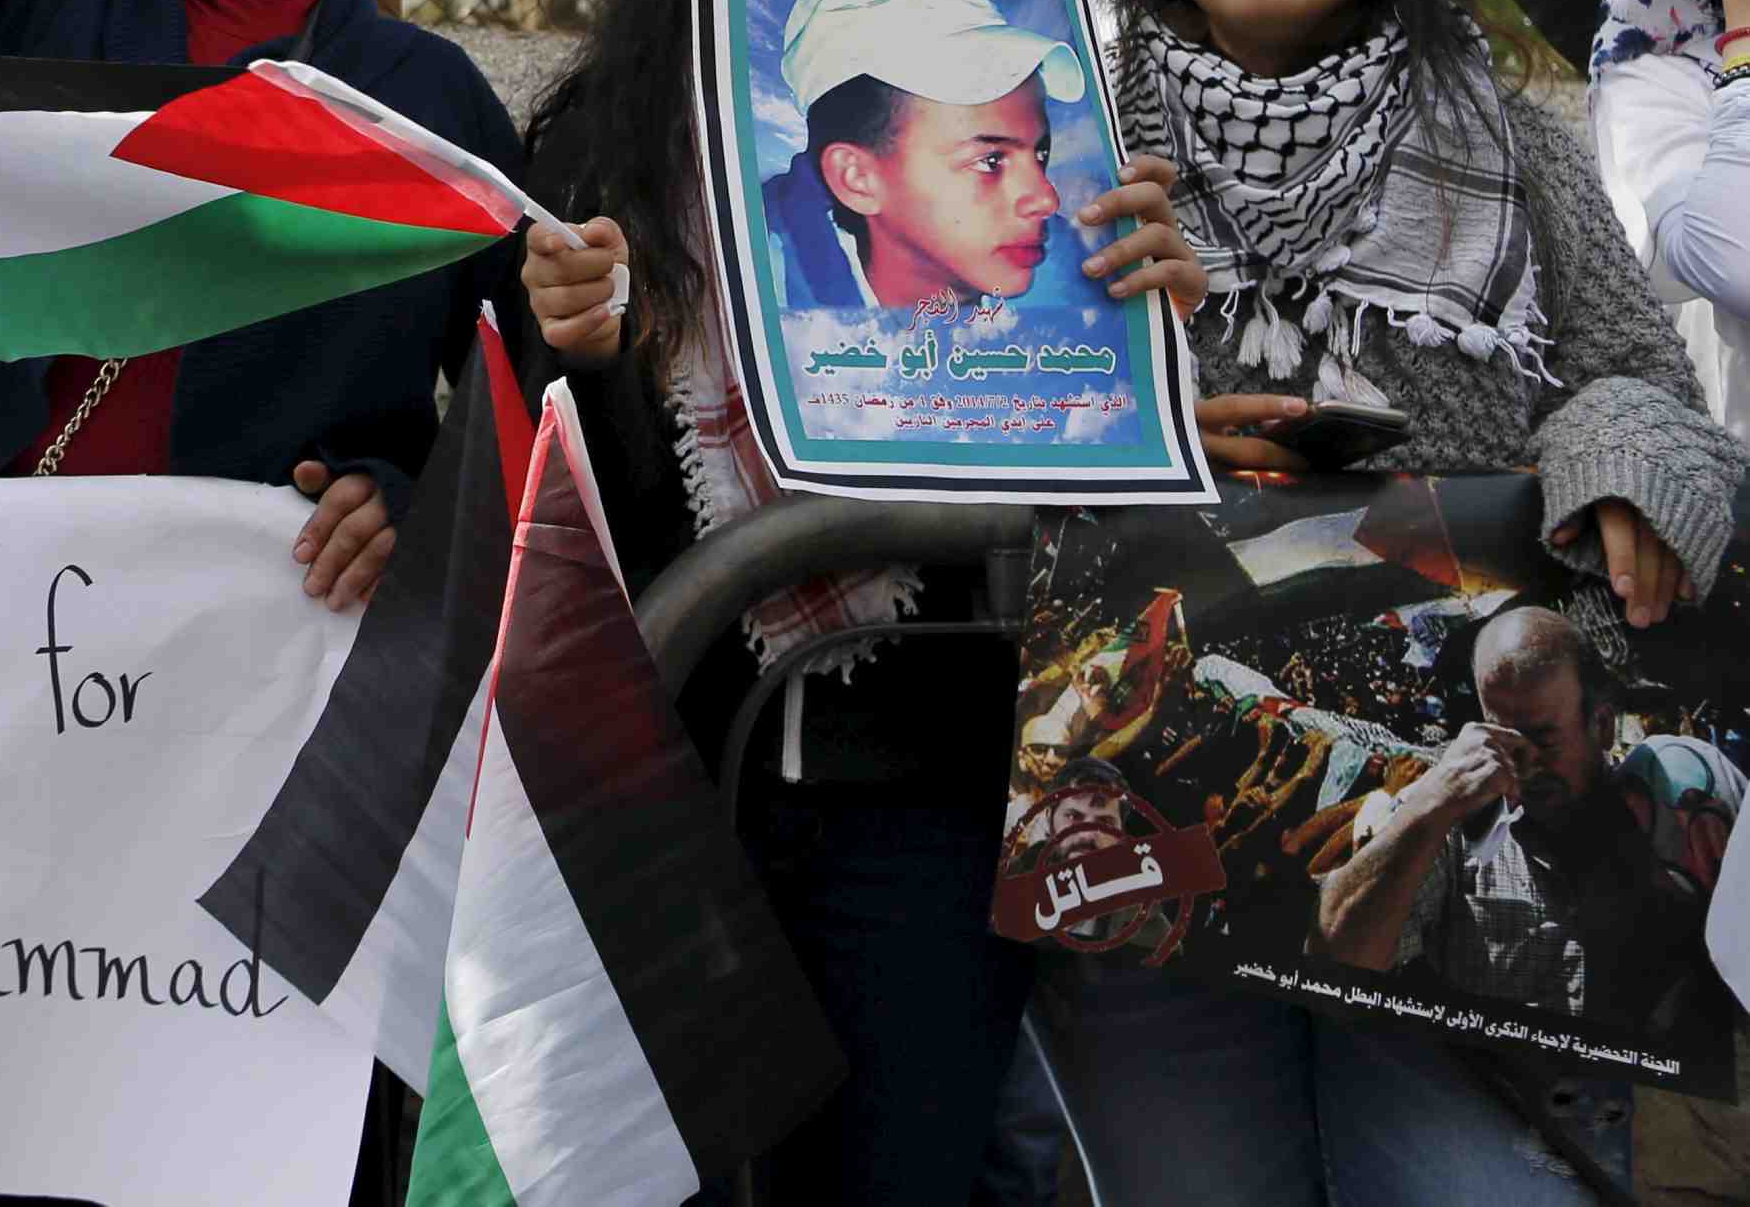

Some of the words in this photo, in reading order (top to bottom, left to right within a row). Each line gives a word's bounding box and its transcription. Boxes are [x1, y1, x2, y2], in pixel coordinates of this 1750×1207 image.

[802, 338, 889, 377] خضير
[900, 329, 939, 381] أبو
[947, 344, 1032, 381] حسين
[1036, 344, 1117, 375] محمد
[35, 564, 153, 734] for
[1035, 842, 1164, 931] قاتل
[1234, 961, 1277, 982] خضير
[1279, 969, 1299, 988] أبو
[1300, 977, 1342, 998] محمد
[1344, 986, 1382, 1009] البطل
[1484, 1020, 1529, 1040] الذكرى
[1571, 1036, 1638, 1066] التحضيرية
[1639, 1051, 1681, 1076] اللجنة
